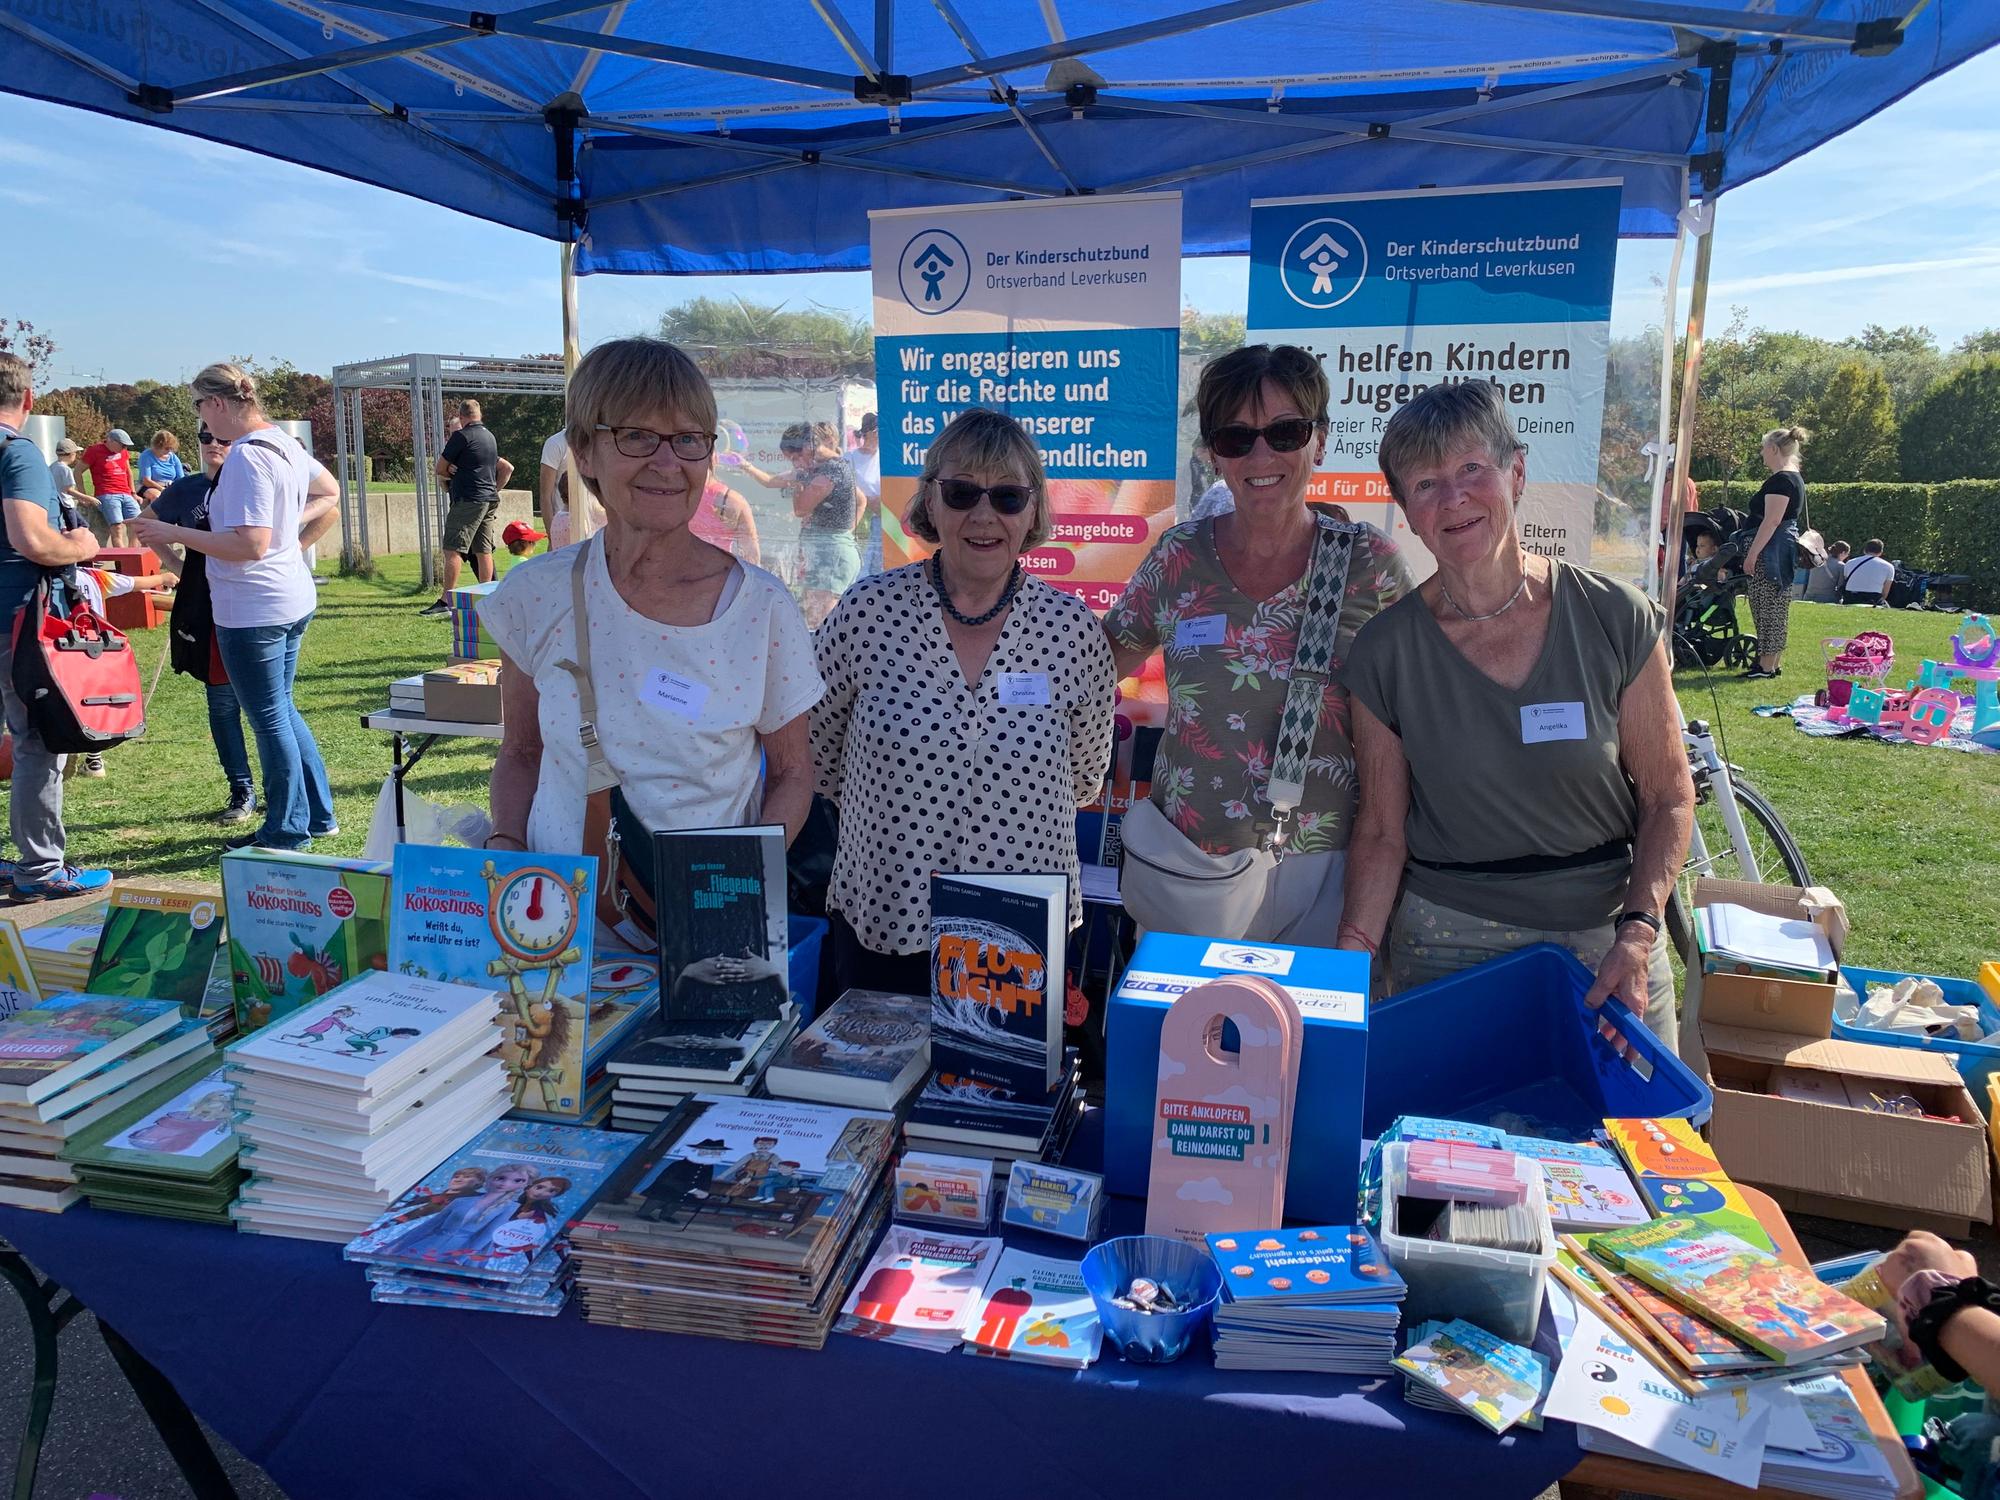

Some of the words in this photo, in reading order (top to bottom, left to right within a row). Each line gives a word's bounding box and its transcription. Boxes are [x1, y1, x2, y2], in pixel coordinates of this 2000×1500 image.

[1387, 242, 1416, 258] Der
[1421, 234, 1580, 256] Kinderschutzbund
[986, 251, 1011, 267] Der
[1015, 244, 1150, 266] Kinderschutzbund
[1385, 263, 1478, 281] Ortsverband
[1485, 261, 1575, 278] Leverkusen
[986, 270, 1065, 290] Ortsverband
[1071, 270, 1147, 286] Leverkusen
[900, 348, 935, 371] Wir
[942, 346, 1068, 377] engagieren
[1078, 348, 1120, 369] uns
[1338, 343, 1432, 372] helfen
[1446, 342, 1570, 371] Kindern
[901, 381, 928, 403] für
[936, 379, 971, 402] die
[979, 379, 1056, 402] Rechte
[1064, 377, 1109, 402] und
[902, 412, 935, 434] das
[1329, 417, 1365, 433] reier
[1518, 417, 1574, 434] Deinen
[1335, 436, 1379, 459] Ängst
[1333, 479, 1360, 497] für
[1523, 524, 1567, 539] Eltern
[1018, 555, 1057, 569] otsen
[1540, 723, 1568, 731] Angelika
[416, 886, 427, 894] Der
[521, 880, 529, 888] 11
[551, 882, 556, 891] 1
[710, 874, 761, 895] Fliegende
[510, 891, 519, 900] 10
[561, 893, 567, 903] 2
[694, 890, 724, 909] Steine
[246, 890, 322, 918] Kokosnuss
[405, 892, 485, 918] Kokosnuss
[506, 906, 513, 915] 9
[564, 910, 570, 920] 3
[425, 920, 449, 932] Weißt
[451, 922, 464, 934] du,
[509, 920, 516, 929] 8
[558, 926, 565, 935] 4
[407, 934, 421, 942] wie
[423, 934, 437, 943] viel
[438, 935, 452, 945] Uhr
[454, 938, 463, 946] es
[465, 938, 480, 947] ist?
[518, 933, 524, 942] 7
[532, 938, 538, 947] 6
[546, 936, 552, 945] 5
[940, 934, 1042, 985] FLUT
[1127, 981, 1159, 990] die
[388, 992, 428, 1003] Fanny
[364, 996, 392, 1004] und
[392, 1000, 412, 1008] die
[413, 1003, 447, 1014] Liebe
[738, 1111, 764, 1119] Herr
[1163, 1103, 1189, 1117] BITTE
[1191, 1105, 1248, 1123] ANKLOPFEN,
[1171, 1123, 1197, 1137] DANN
[1200, 1125, 1235, 1140] DARFST
[1238, 1128, 1250, 1141] DU
[1176, 1141, 1241, 1158] REINKOMMEN.
[498, 1229, 534, 1242] POSTER
[912, 1243, 937, 1251] ALLEIN
[1337, 1247, 1352, 1255] Wie
[1264, 1255, 1345, 1268] Kindeswohl
[1032, 1275, 1059, 1284] GROSSE
[1596, 1346, 1634, 1363] HELLO
